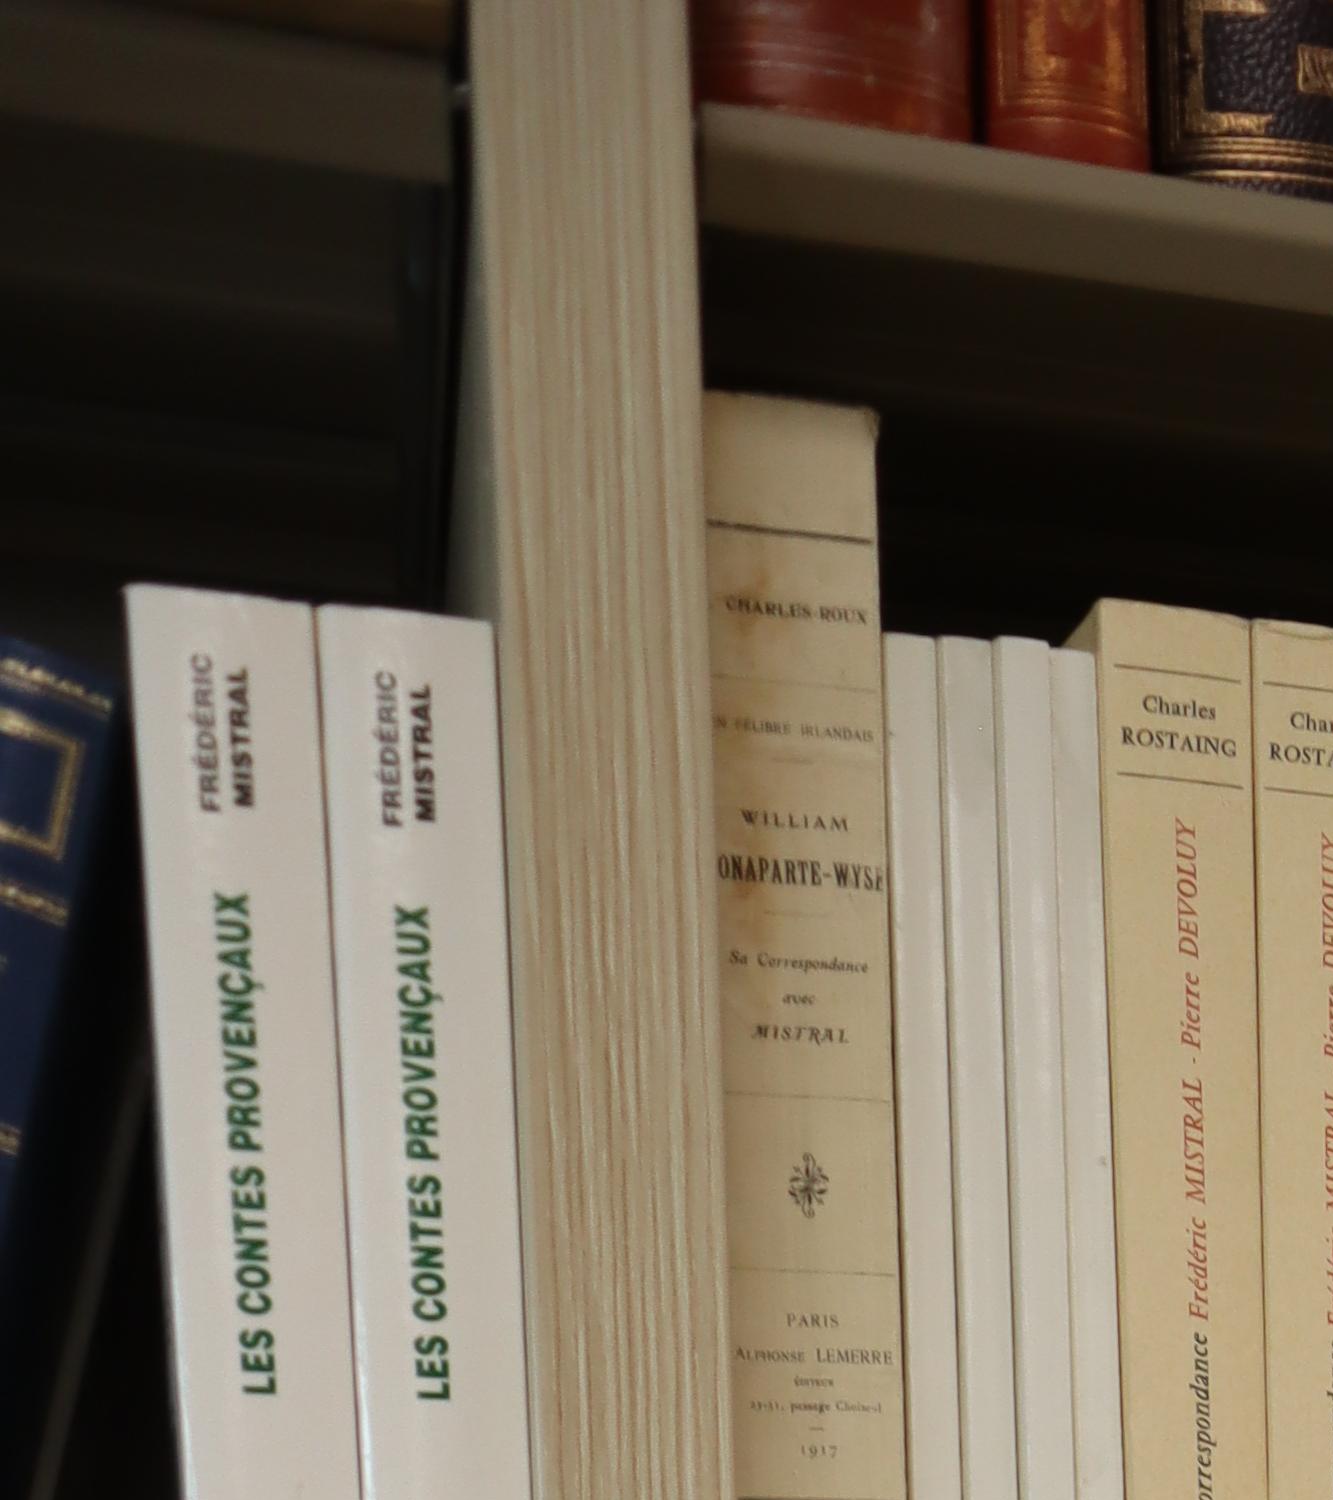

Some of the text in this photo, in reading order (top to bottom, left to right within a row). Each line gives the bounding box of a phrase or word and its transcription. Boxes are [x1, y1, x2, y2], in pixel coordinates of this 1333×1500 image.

[190, 653, 220, 812] FRÉDÉRIC
[231, 665, 256, 807] MISTRAL
[1121, 726, 1237, 758] ROSTAING
[1143, 695, 1216, 720] Charles
[1174, 817, 1199, 959] DEVOLUY
[1180, 971, 1200, 1050] Pierre
[213, 889, 279, 1397] LES CONTES PROVENÇAUX
[1183, 1076, 1205, 1204] MISTRAL
[1188, 1217, 1209, 1322] Frédéric
